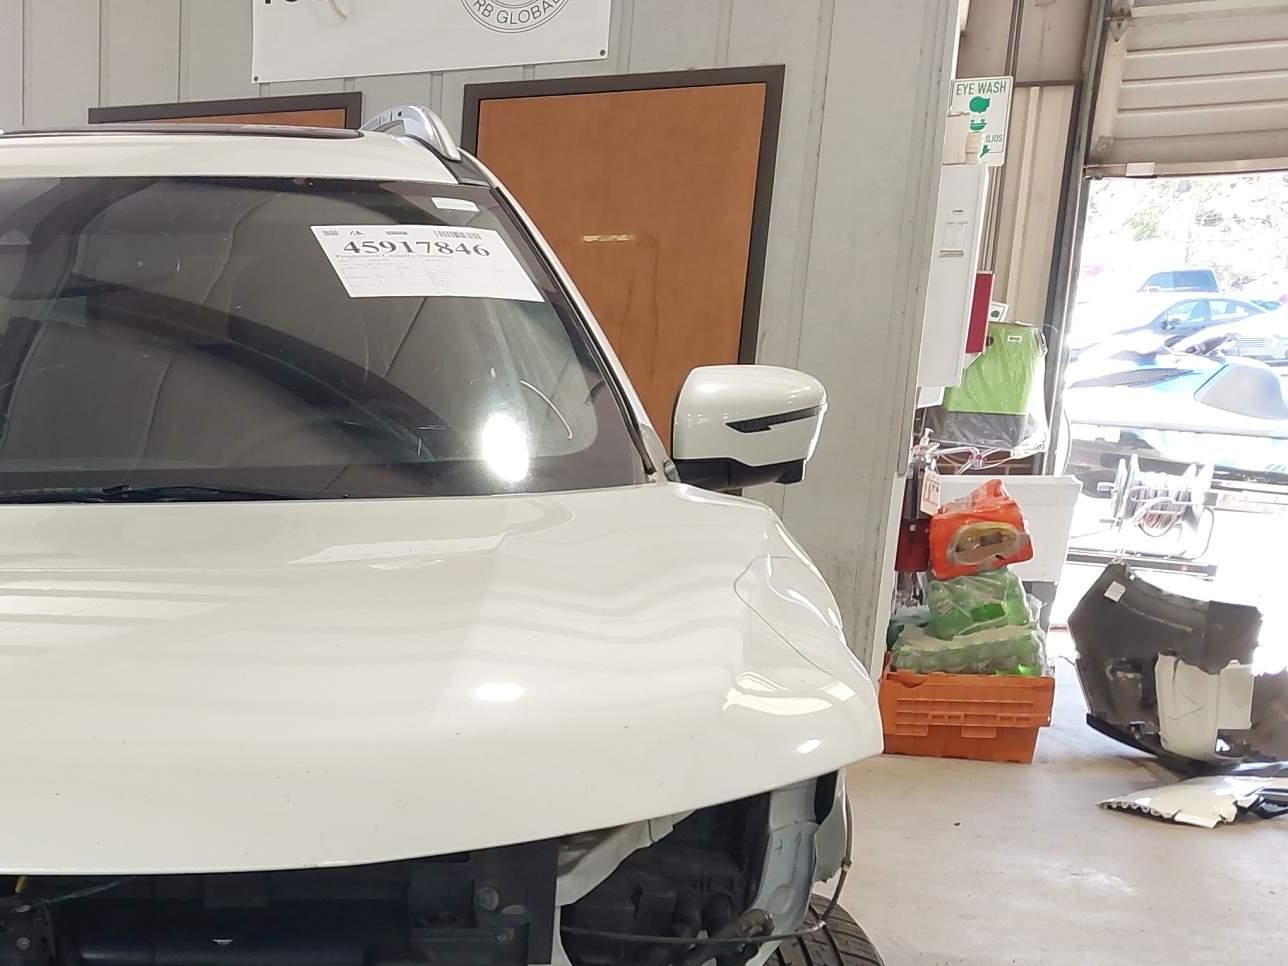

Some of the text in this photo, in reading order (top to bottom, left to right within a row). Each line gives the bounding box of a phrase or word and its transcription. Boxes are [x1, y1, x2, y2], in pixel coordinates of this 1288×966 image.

[956, 81, 1007, 95] EYE WASH
[343, 240, 490, 256] 45917846
